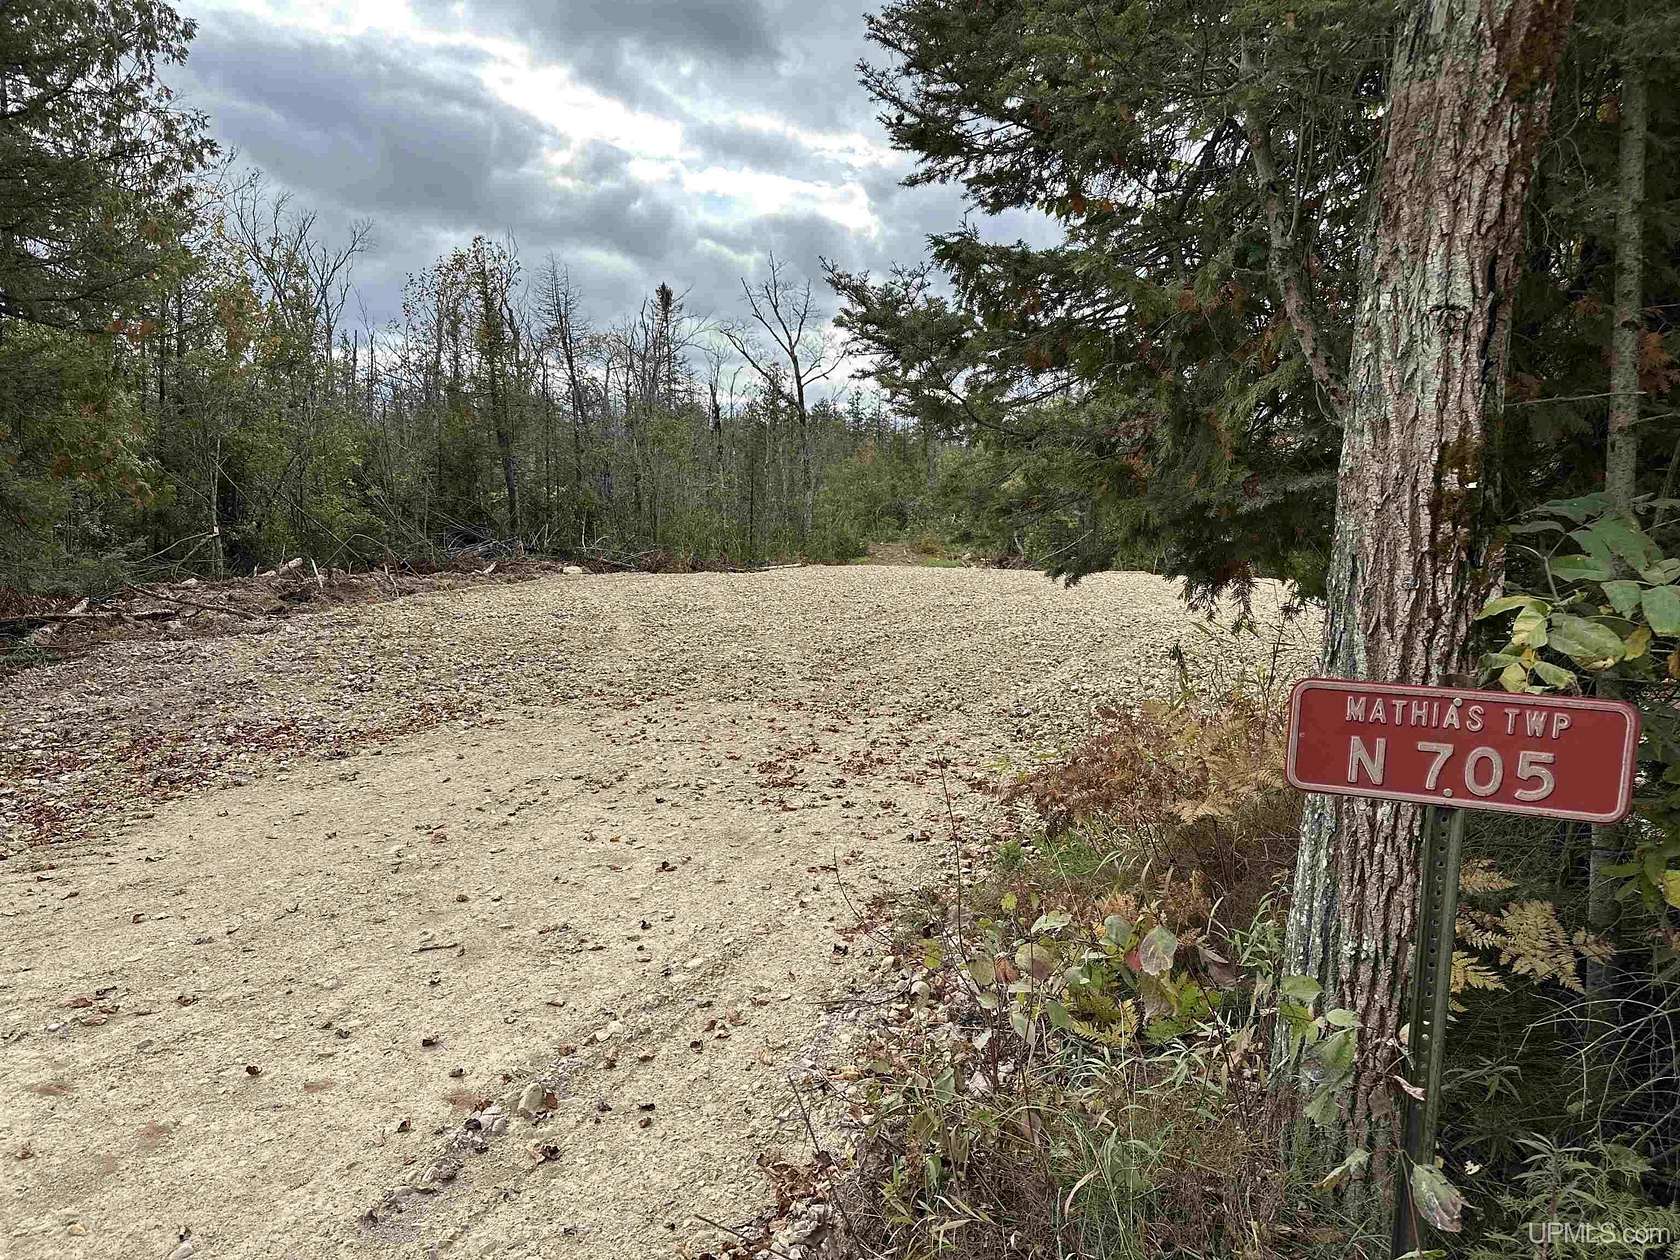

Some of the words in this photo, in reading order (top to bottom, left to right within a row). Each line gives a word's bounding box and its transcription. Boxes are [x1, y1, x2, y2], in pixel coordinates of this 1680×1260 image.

[1345, 695, 1485, 732] MATHIAS
[1504, 708, 1572, 739] TWP
[1346, 735, 1387, 786] N
[1417, 740, 1556, 802] 705
